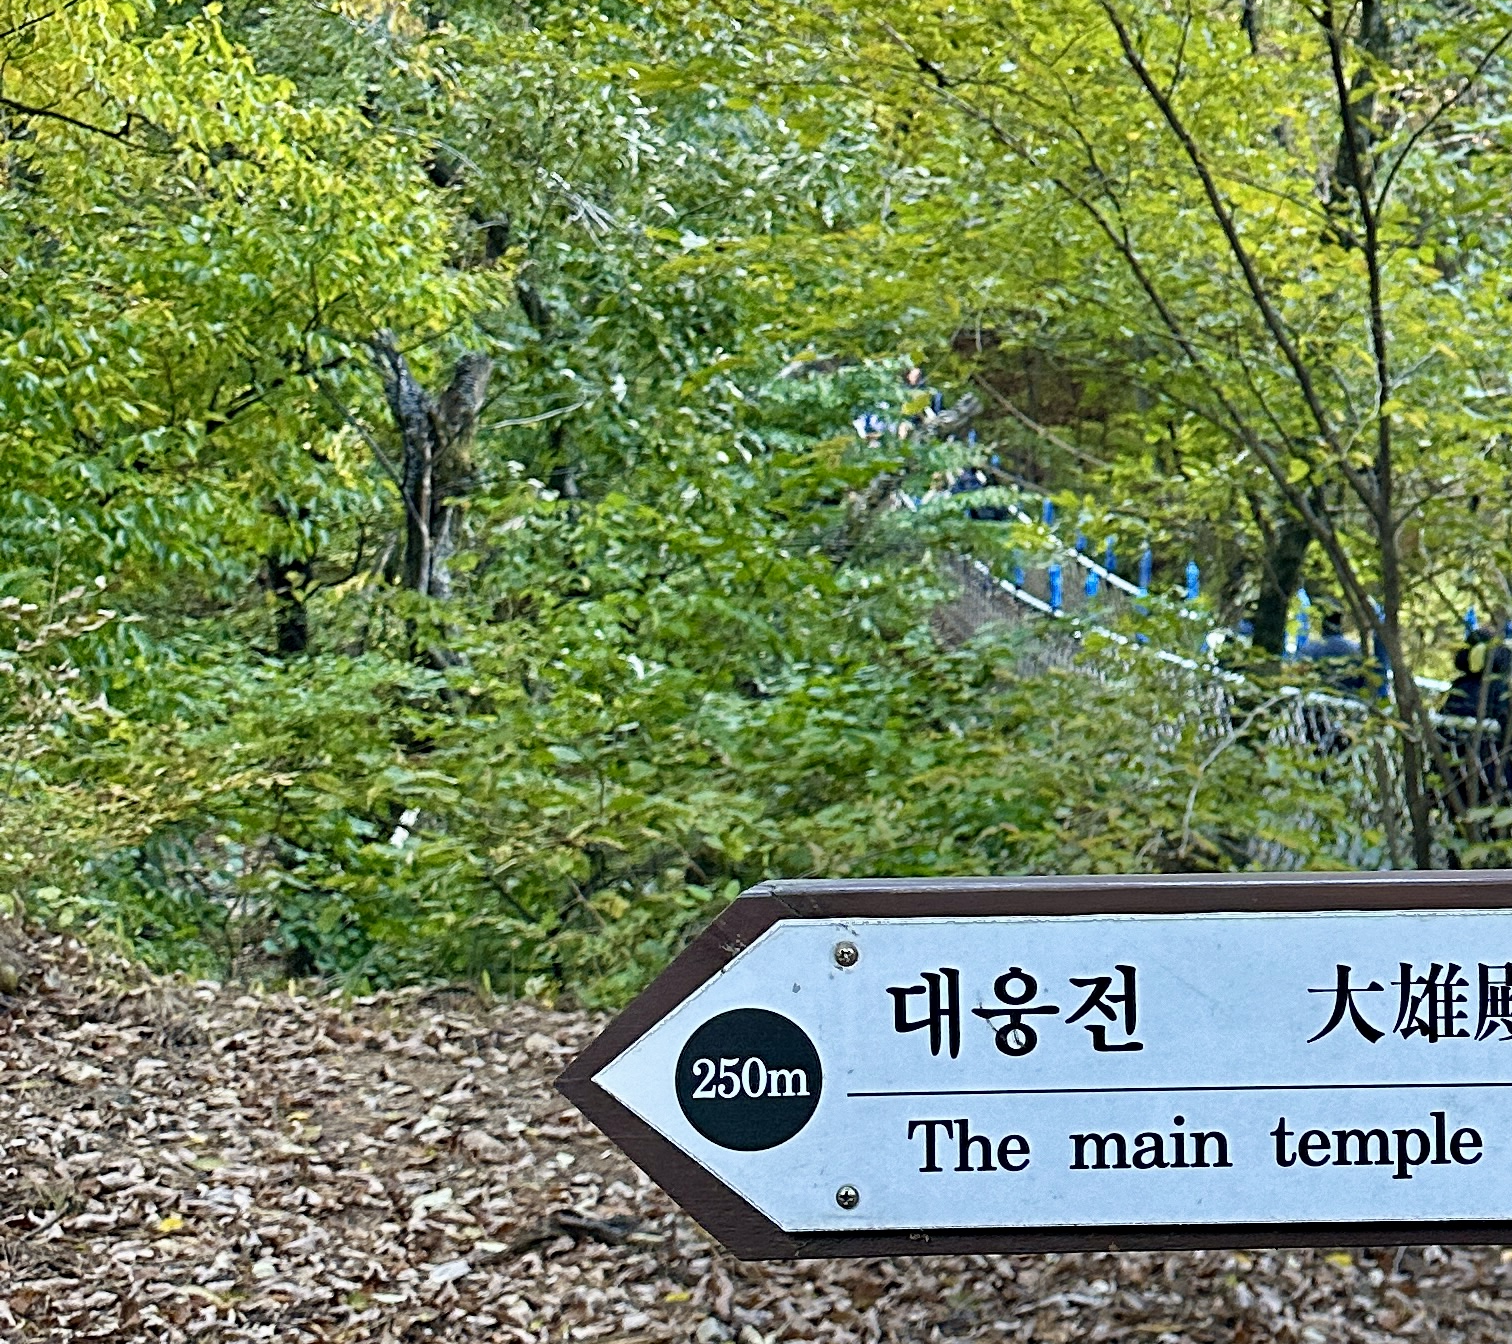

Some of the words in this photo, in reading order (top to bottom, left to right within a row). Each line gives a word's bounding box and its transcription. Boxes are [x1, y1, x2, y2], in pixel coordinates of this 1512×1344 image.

[886, 964, 1143, 1059] 대웅전
[693, 1057, 811, 1100] 250m
[908, 1119, 1030, 1174] The
[1069, 1116, 1233, 1170] main
[1270, 1112, 1483, 1180] temple
